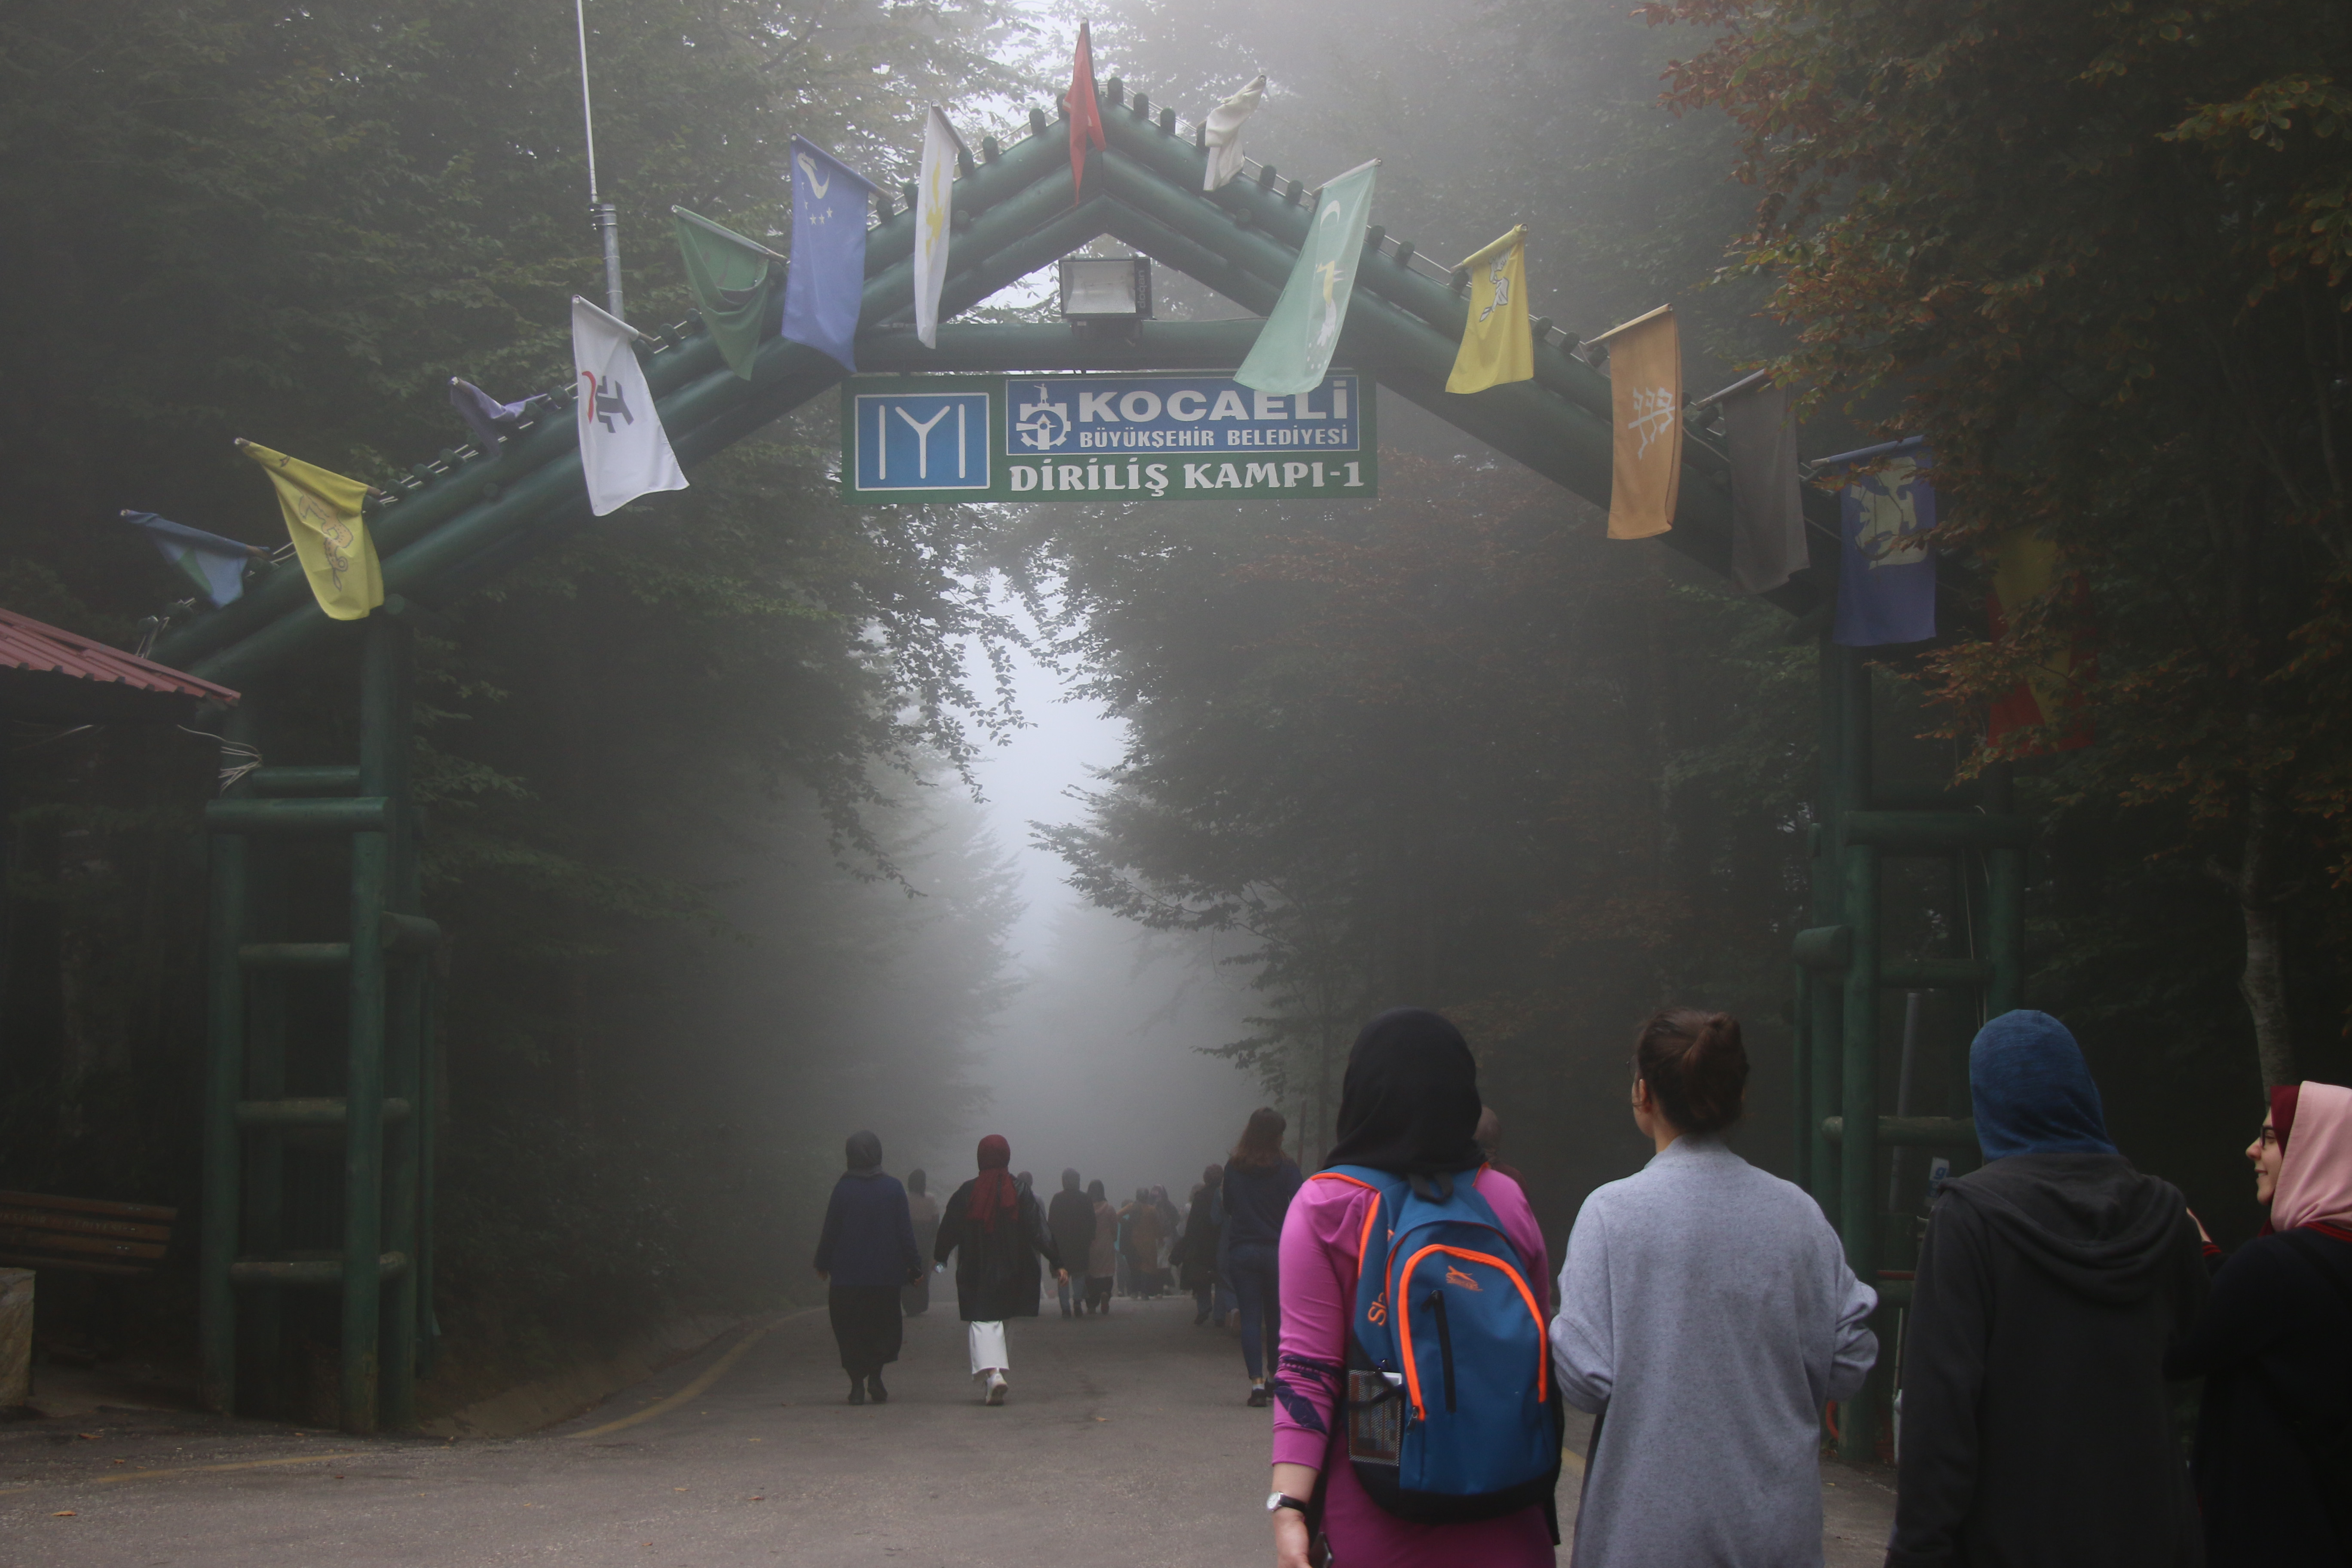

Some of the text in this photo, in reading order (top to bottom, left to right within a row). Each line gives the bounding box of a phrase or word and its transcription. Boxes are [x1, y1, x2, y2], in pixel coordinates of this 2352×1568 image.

[1079, 380, 1347, 422] KOCAELİ
[1080, 424, 1348, 448] BÜYÜKŞEHİR BELEDİYESİ
[1009, 457, 1364, 497] DİRİLİŞ KAMPI-1
